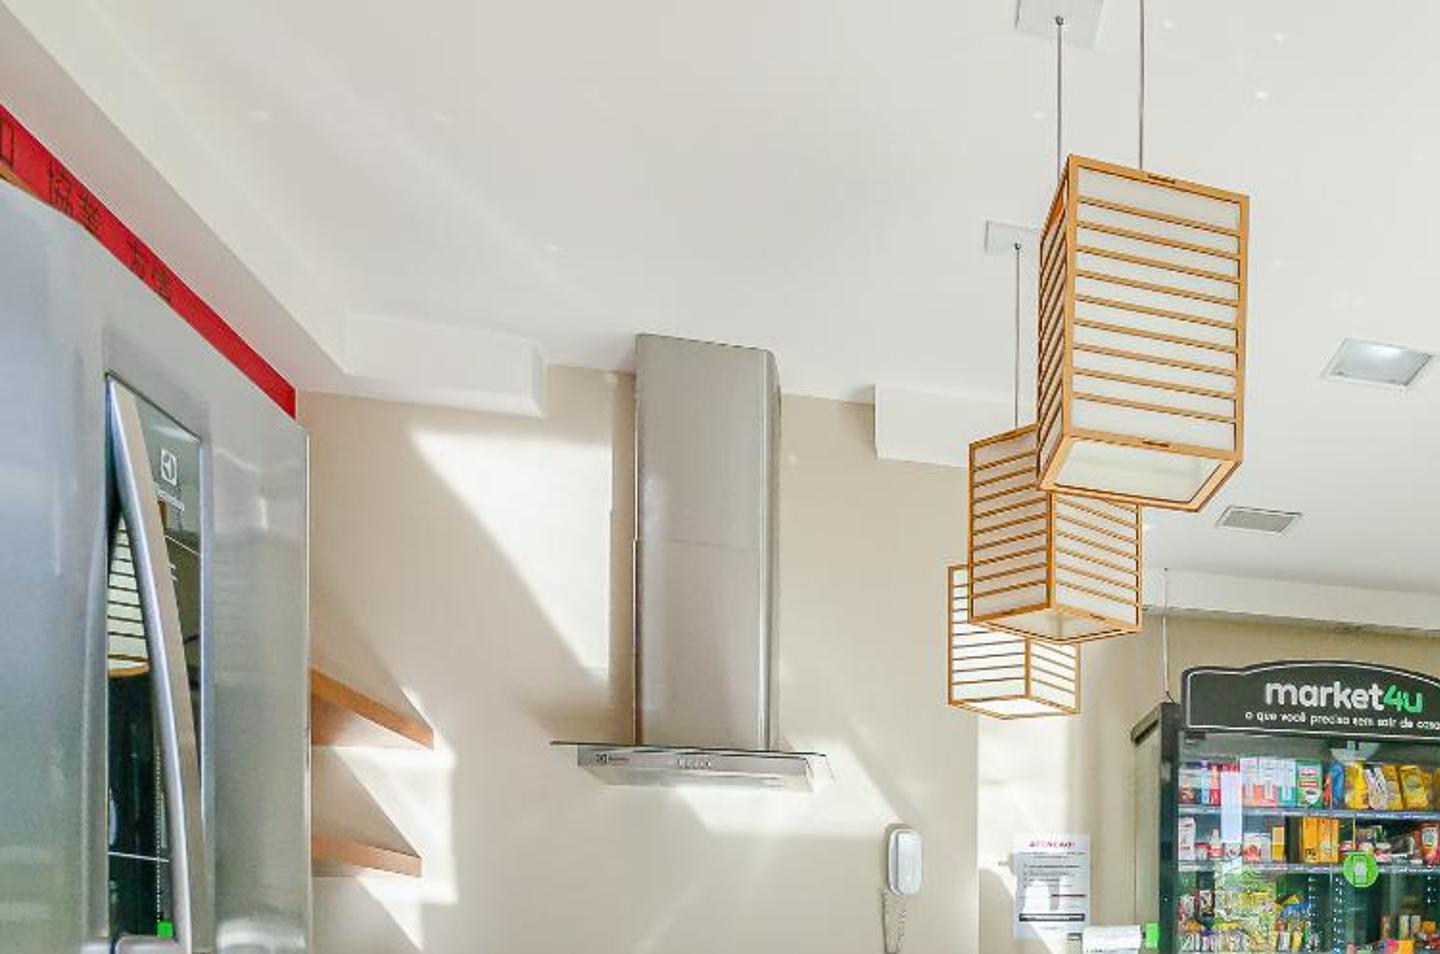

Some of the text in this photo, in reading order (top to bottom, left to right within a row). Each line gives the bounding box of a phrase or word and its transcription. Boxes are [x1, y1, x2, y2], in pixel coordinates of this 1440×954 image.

[1264, 681, 1424, 714] market4u
[1245, 711, 1253, 720] o
[1256, 712, 1277, 722] que
[1310, 713, 1350, 726] precisa
[1353, 717, 1375, 726] sem
[1400, 718, 1414, 729] de
[1417, 721, 1440, 730] casa
